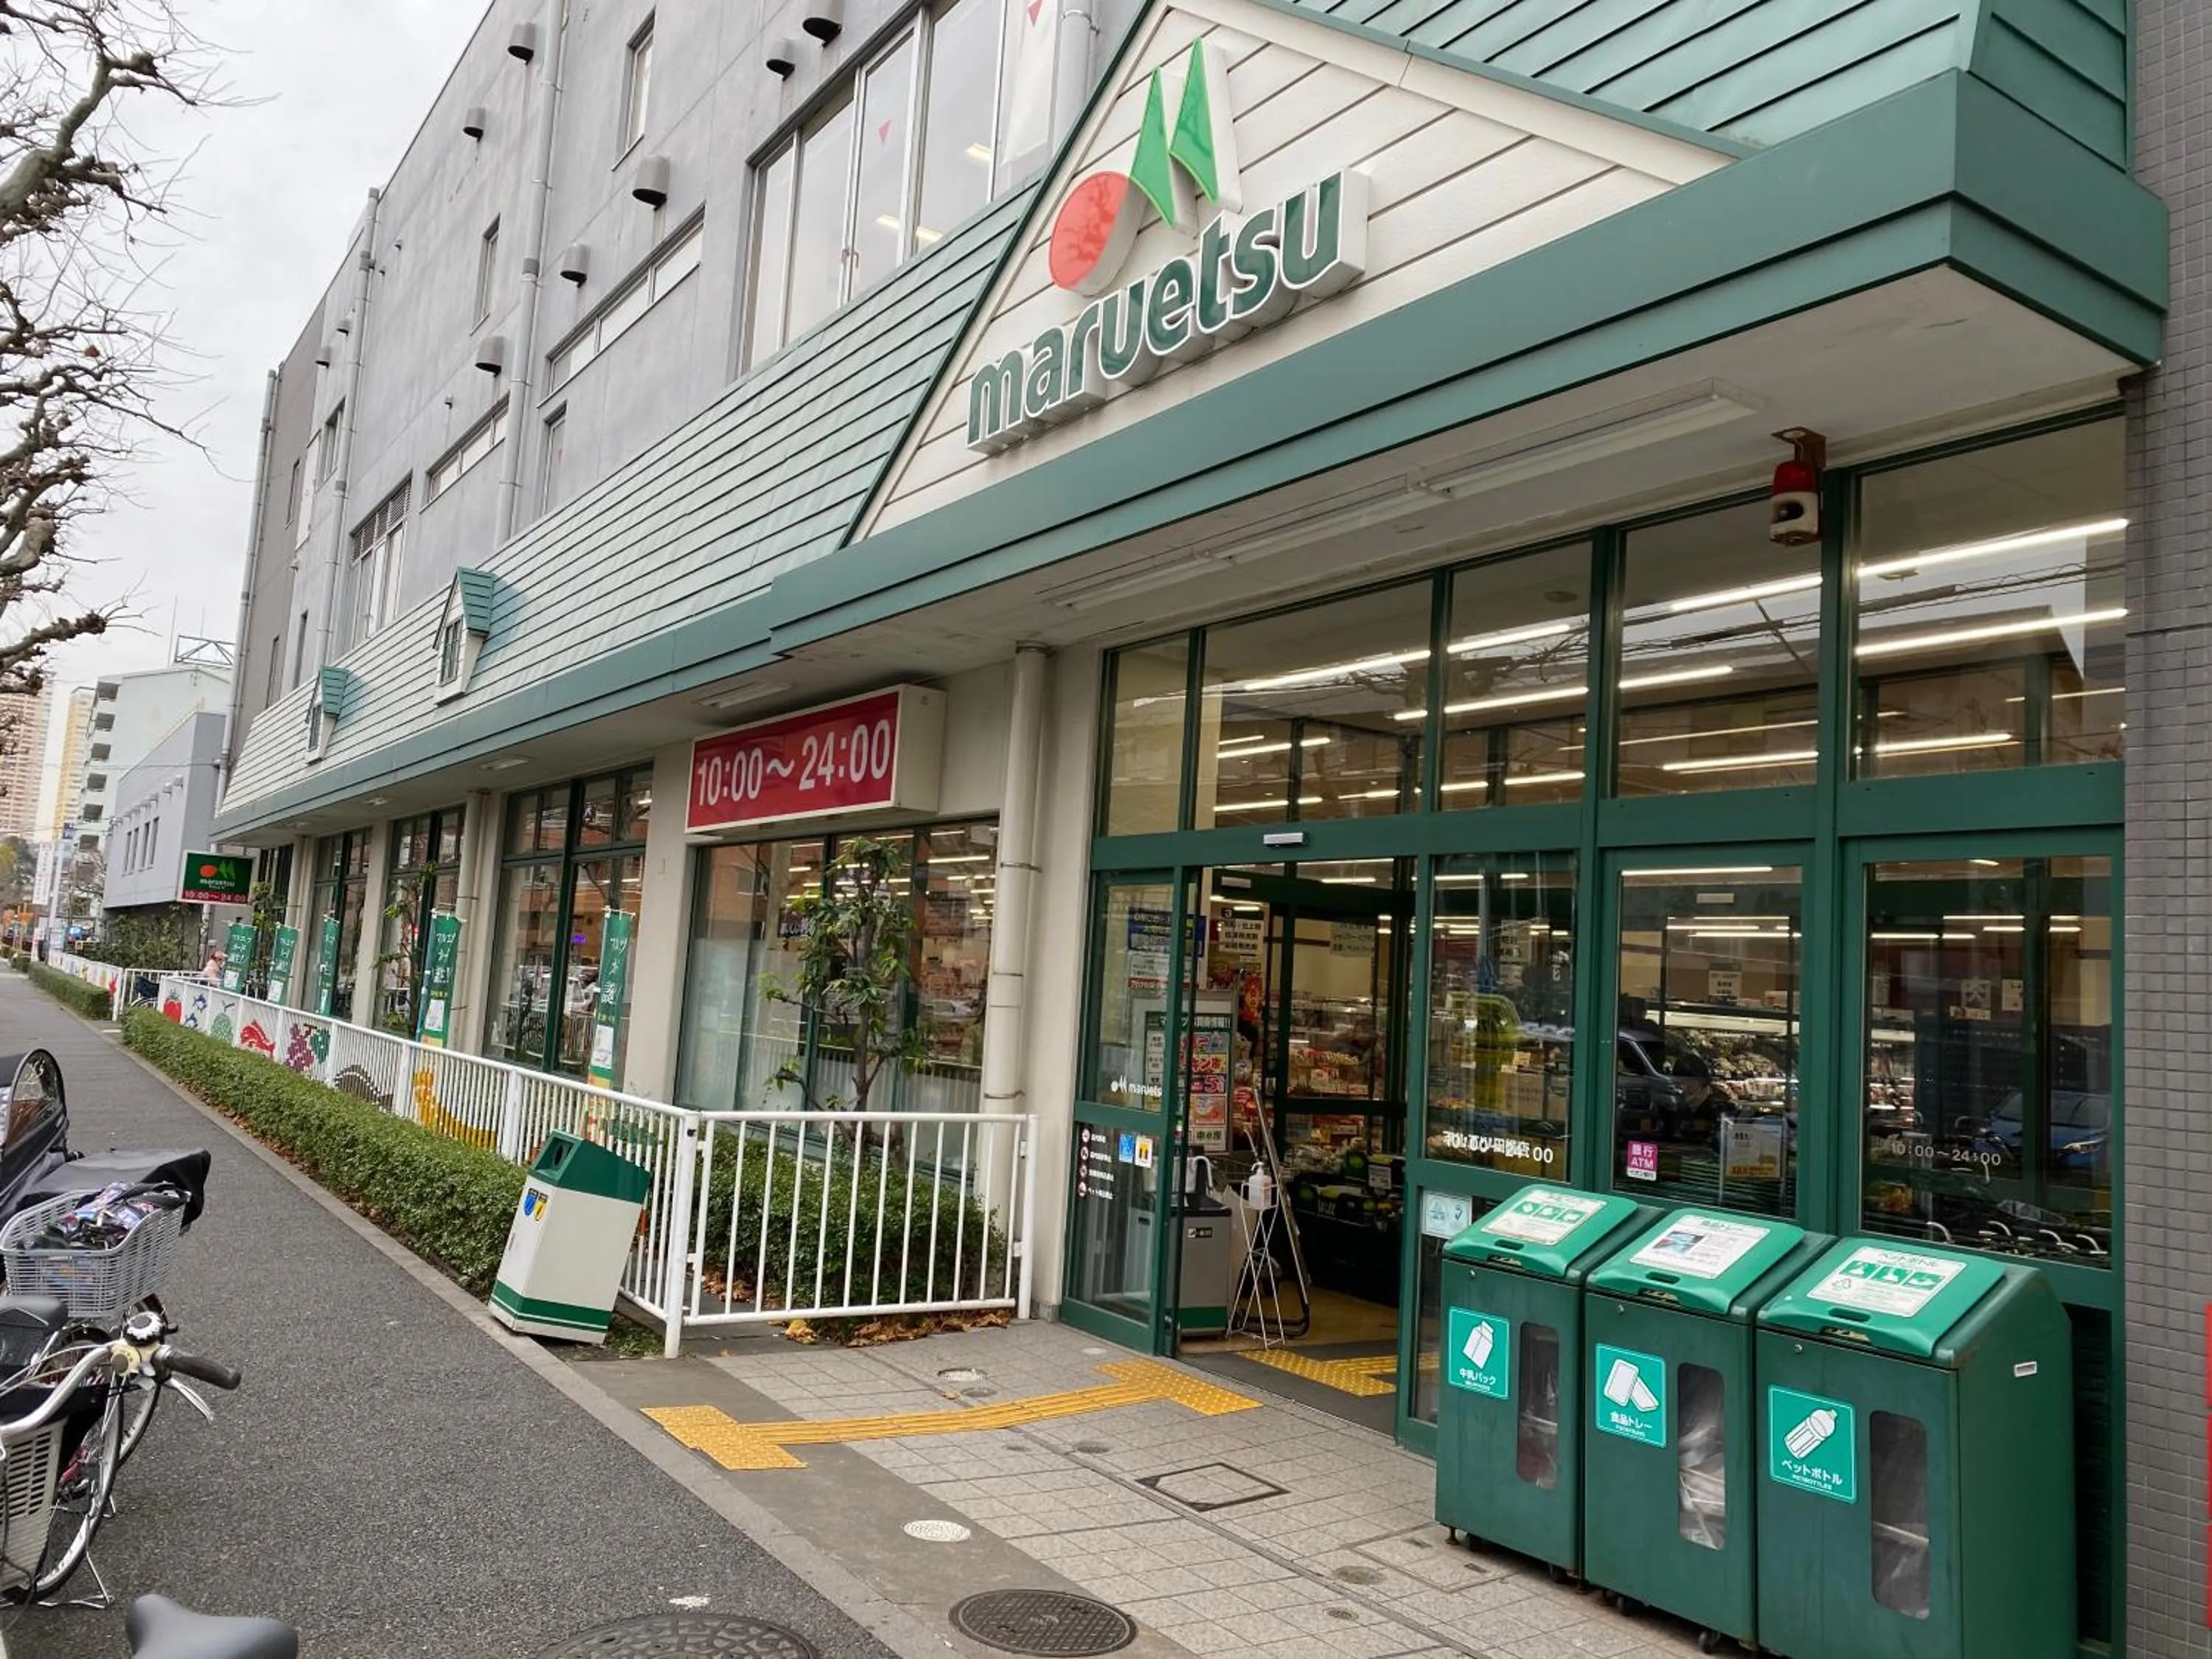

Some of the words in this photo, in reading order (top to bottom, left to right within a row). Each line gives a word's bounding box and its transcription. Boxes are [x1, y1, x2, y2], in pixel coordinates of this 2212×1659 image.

[967, 168, 1346, 451] maruetsu
[1129, 1082, 1163, 1098] maruets
[1631, 1156, 1654, 1169] ATM
[1459, 1368, 1497, 1385] 牛乳パック
[1610, 1411, 1652, 1429] 食品トレー
[1781, 1459, 1843, 1486] ペットボトル
